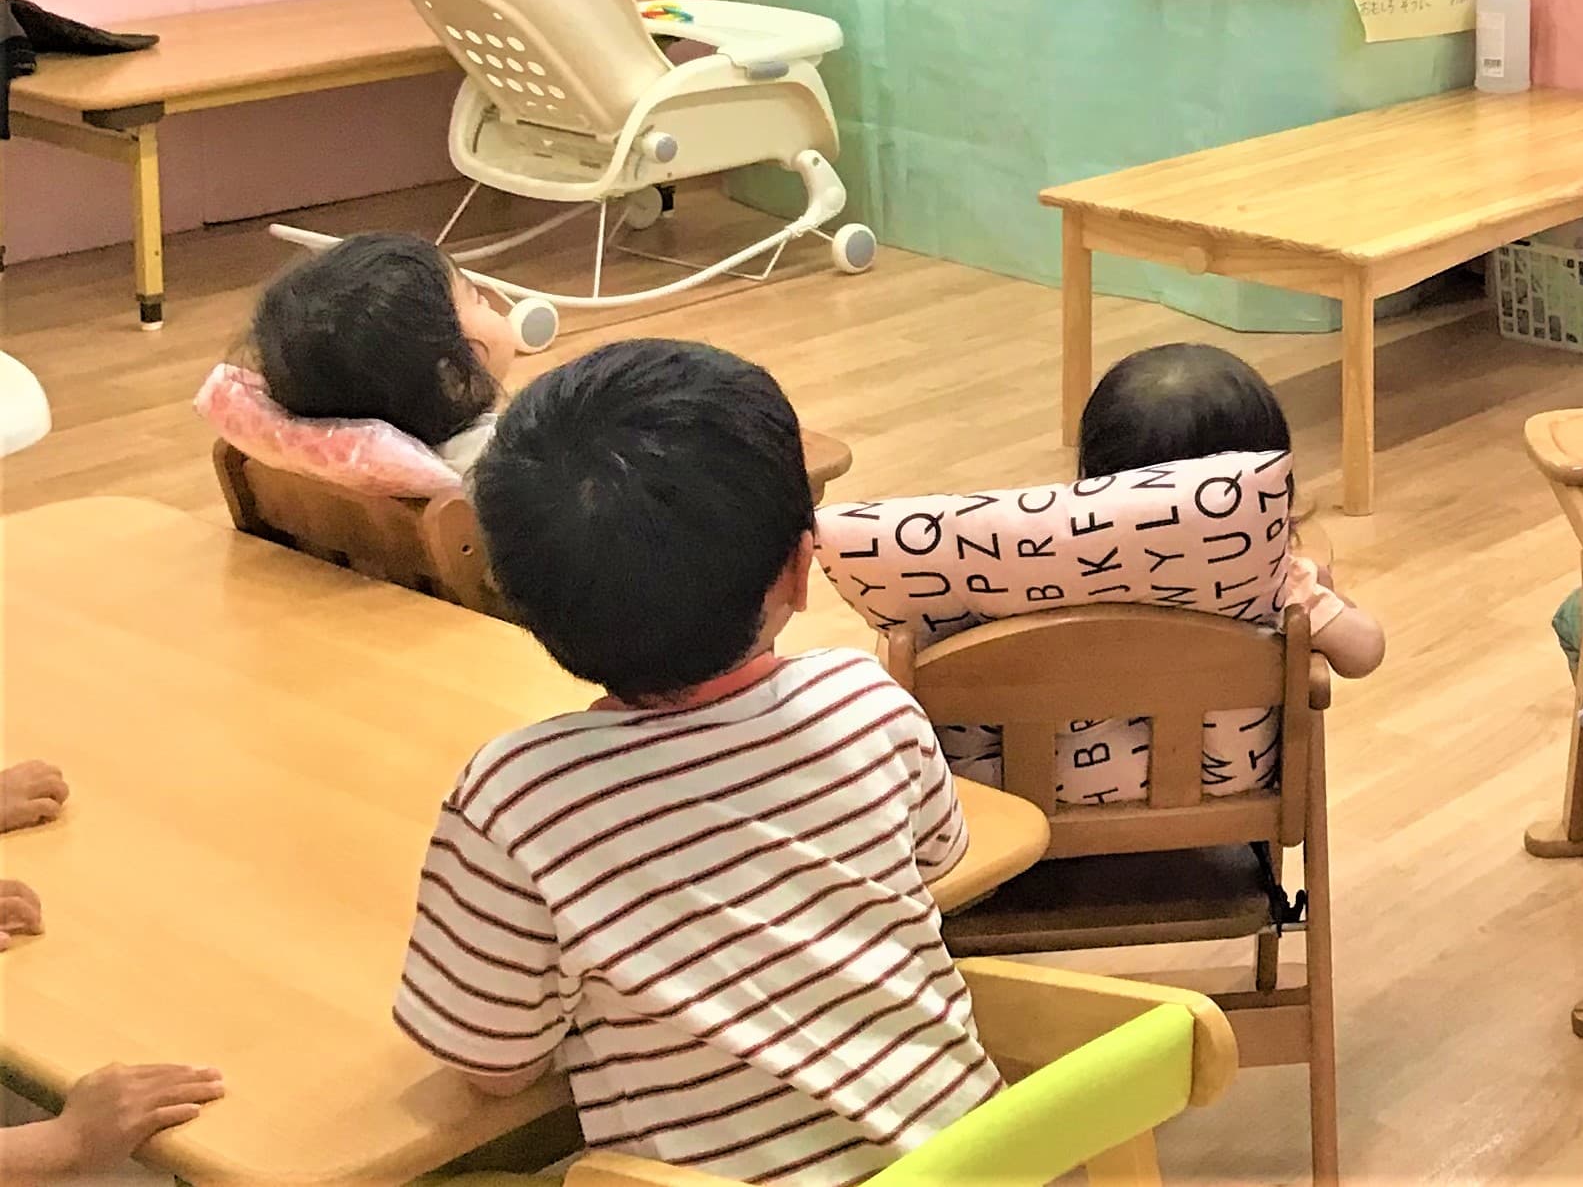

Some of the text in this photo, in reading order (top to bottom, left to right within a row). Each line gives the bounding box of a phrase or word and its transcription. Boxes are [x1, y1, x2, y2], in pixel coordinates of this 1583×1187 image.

[1195, 469, 1243, 519] Q
[1070, 512, 1114, 537] F
[1135, 506, 1180, 531] L
[895, 511, 945, 555] Q
[955, 494, 1009, 594] P Z V
[1017, 490, 1065, 602] B R C
[839, 537, 879, 559] L
[1144, 549, 1185, 574] Y
[1203, 531, 1252, 565] U
[1077, 547, 1123, 578] K
[850, 573, 886, 596] Y
[900, 571, 951, 598] U
[1088, 584, 1131, 597] J
[1215, 576, 1259, 600] T
[1073, 742, 1111, 769] B
